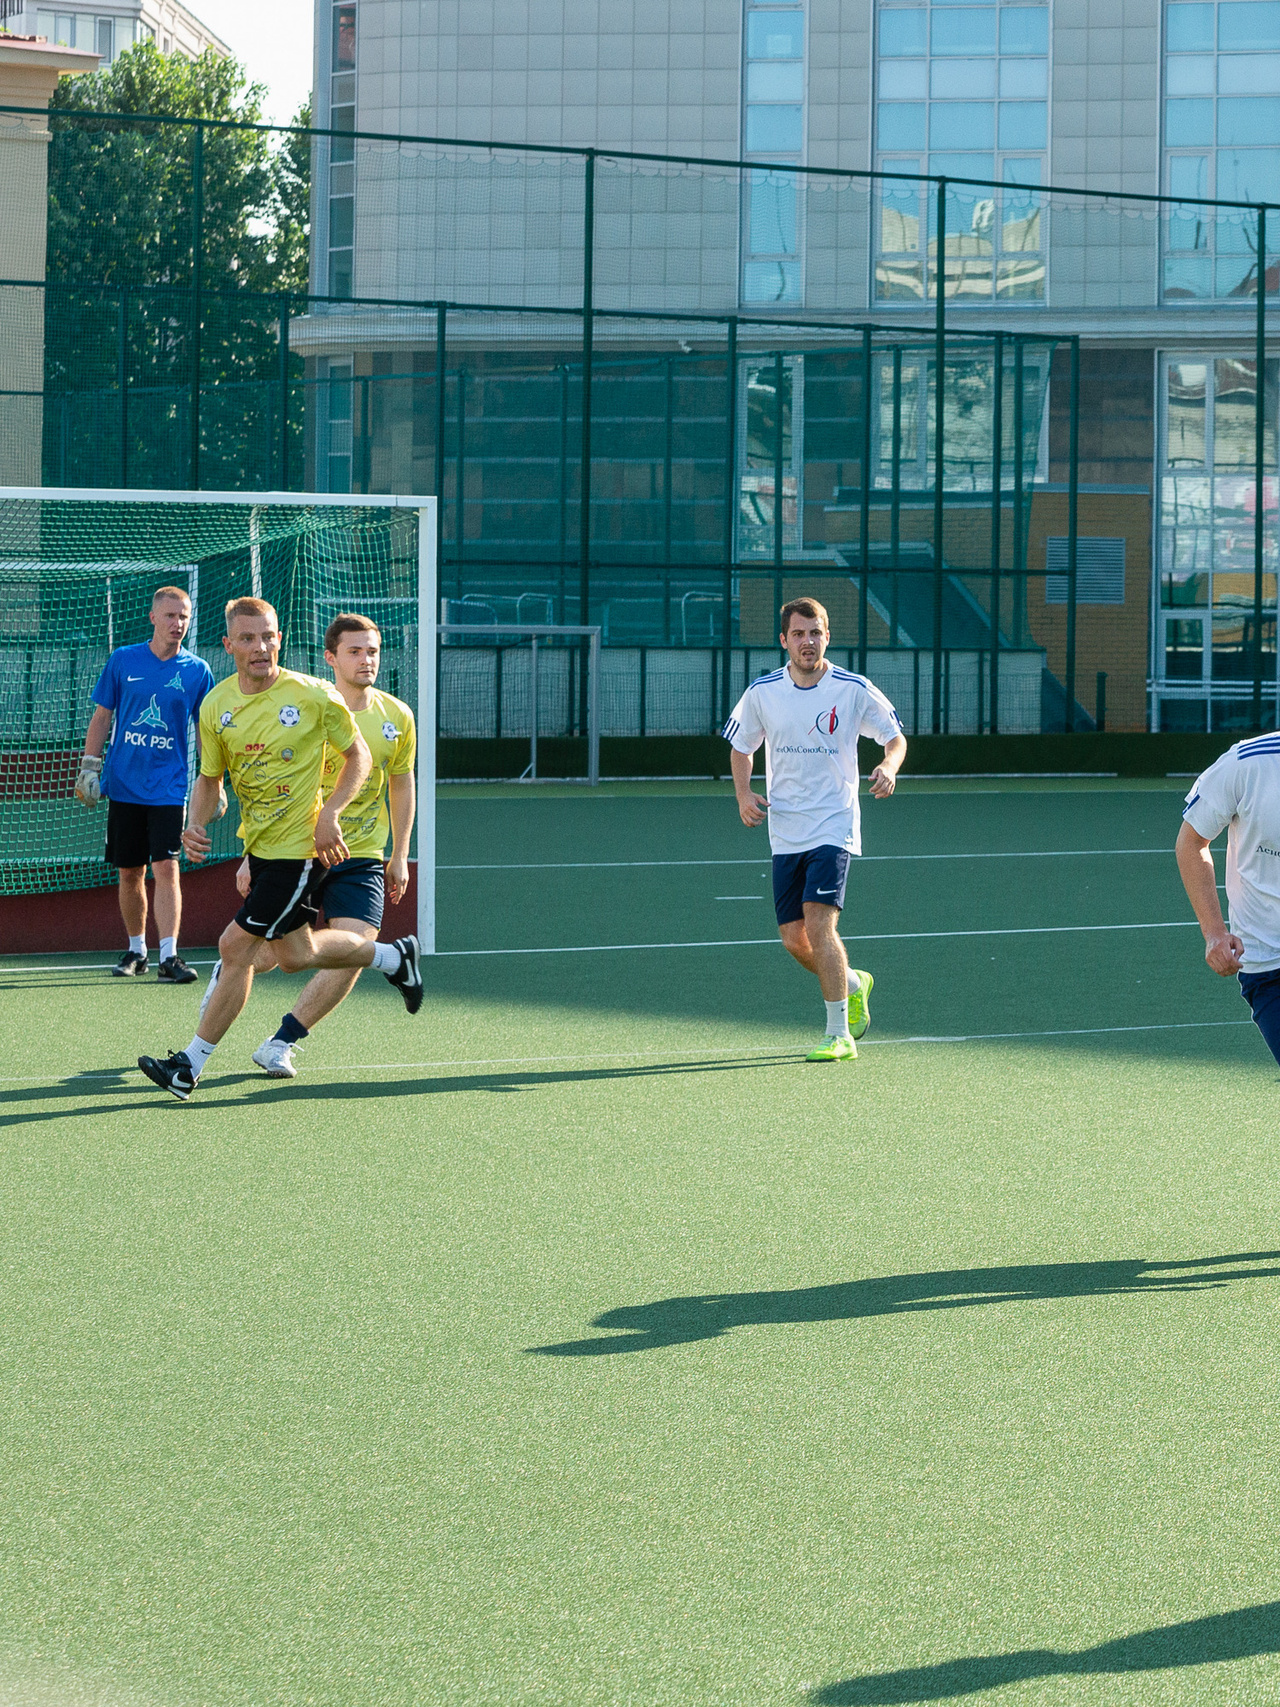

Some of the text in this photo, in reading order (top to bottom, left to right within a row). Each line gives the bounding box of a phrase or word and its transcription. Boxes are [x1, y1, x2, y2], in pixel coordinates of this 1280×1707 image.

[124, 731, 175, 750] РСК РЭС
[275, 784, 290, 794] 15
